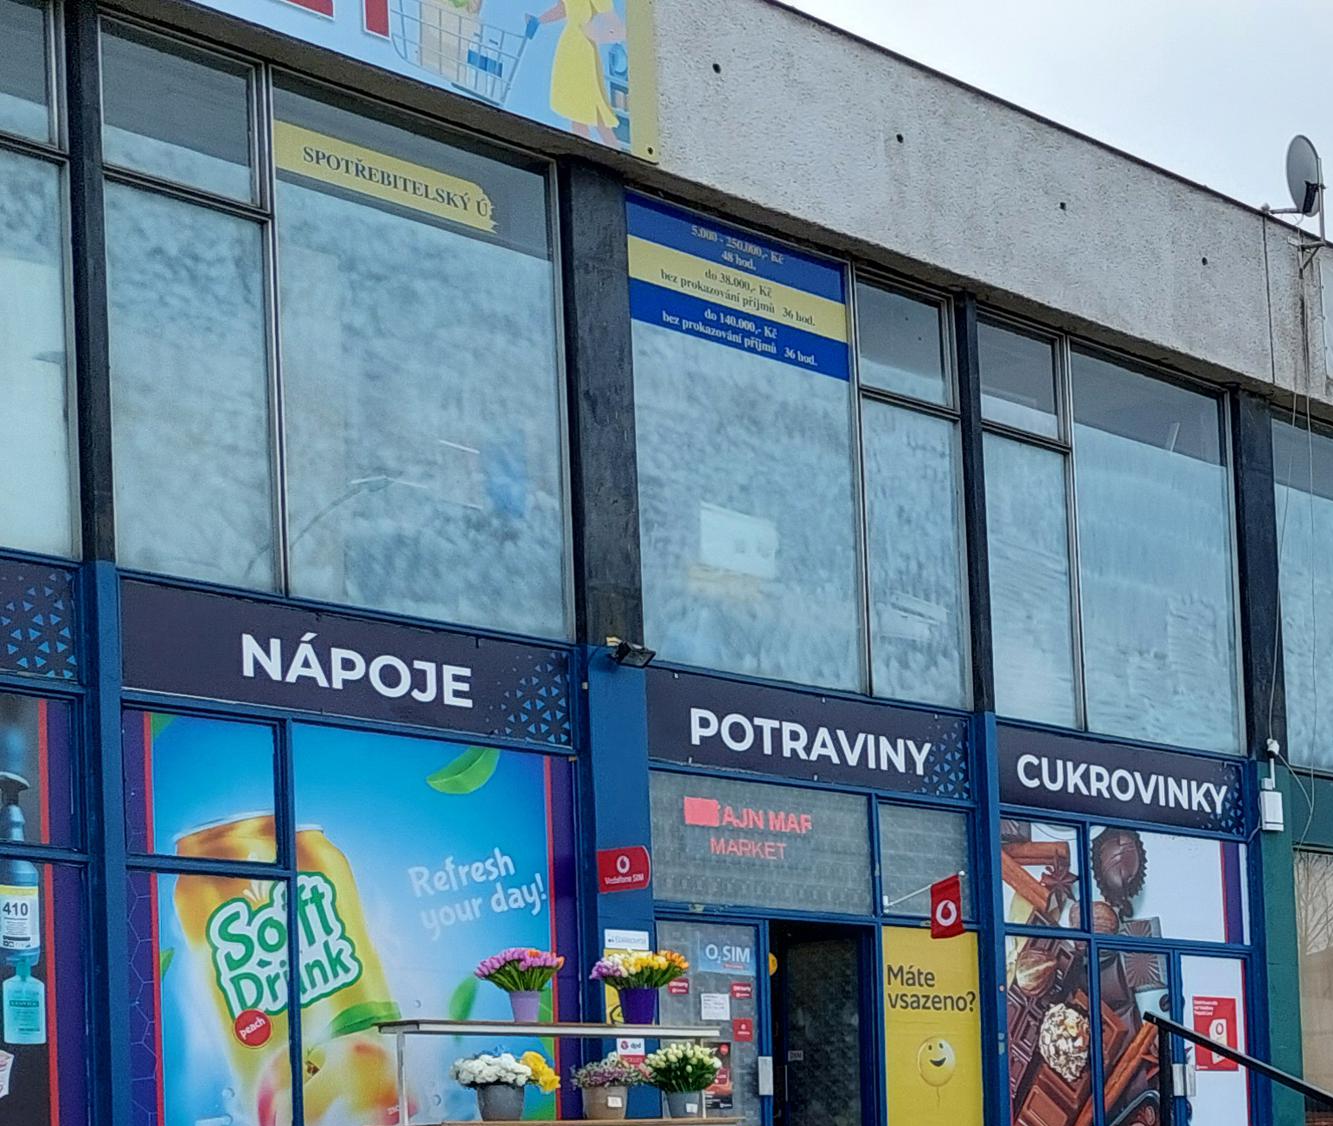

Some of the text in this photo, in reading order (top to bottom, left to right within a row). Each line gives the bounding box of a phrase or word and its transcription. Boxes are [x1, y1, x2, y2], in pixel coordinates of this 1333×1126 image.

[303, 146, 470, 211] SPOTŘEBITELSKÝ
[705, 269, 717, 281] do
[759, 284, 772, 298] Kč
[721, 251, 756, 270] 48 hod.
[661, 269, 816, 327] bez prokazování příjmů 36 hod.
[704, 308, 717, 320] do
[764, 326, 778, 339] Kč
[662, 311, 818, 366] bez prokazování příjmů 36 hod.
[241, 633, 474, 709] NÁPOJE
[689, 707, 932, 776] POTRAVINY
[1016, 754, 1229, 815] CUKROVINKY
[407, 847, 516, 898] Refresh
[710, 837, 787, 860] MARKET
[218, 884, 333, 971] Soft
[420, 873, 547, 941] your day!
[722, 945, 751, 963] SIM
[887, 964, 936, 988] Máte
[888, 991, 976, 1013] vsazeno?
[239, 1016, 266, 1040] peach
